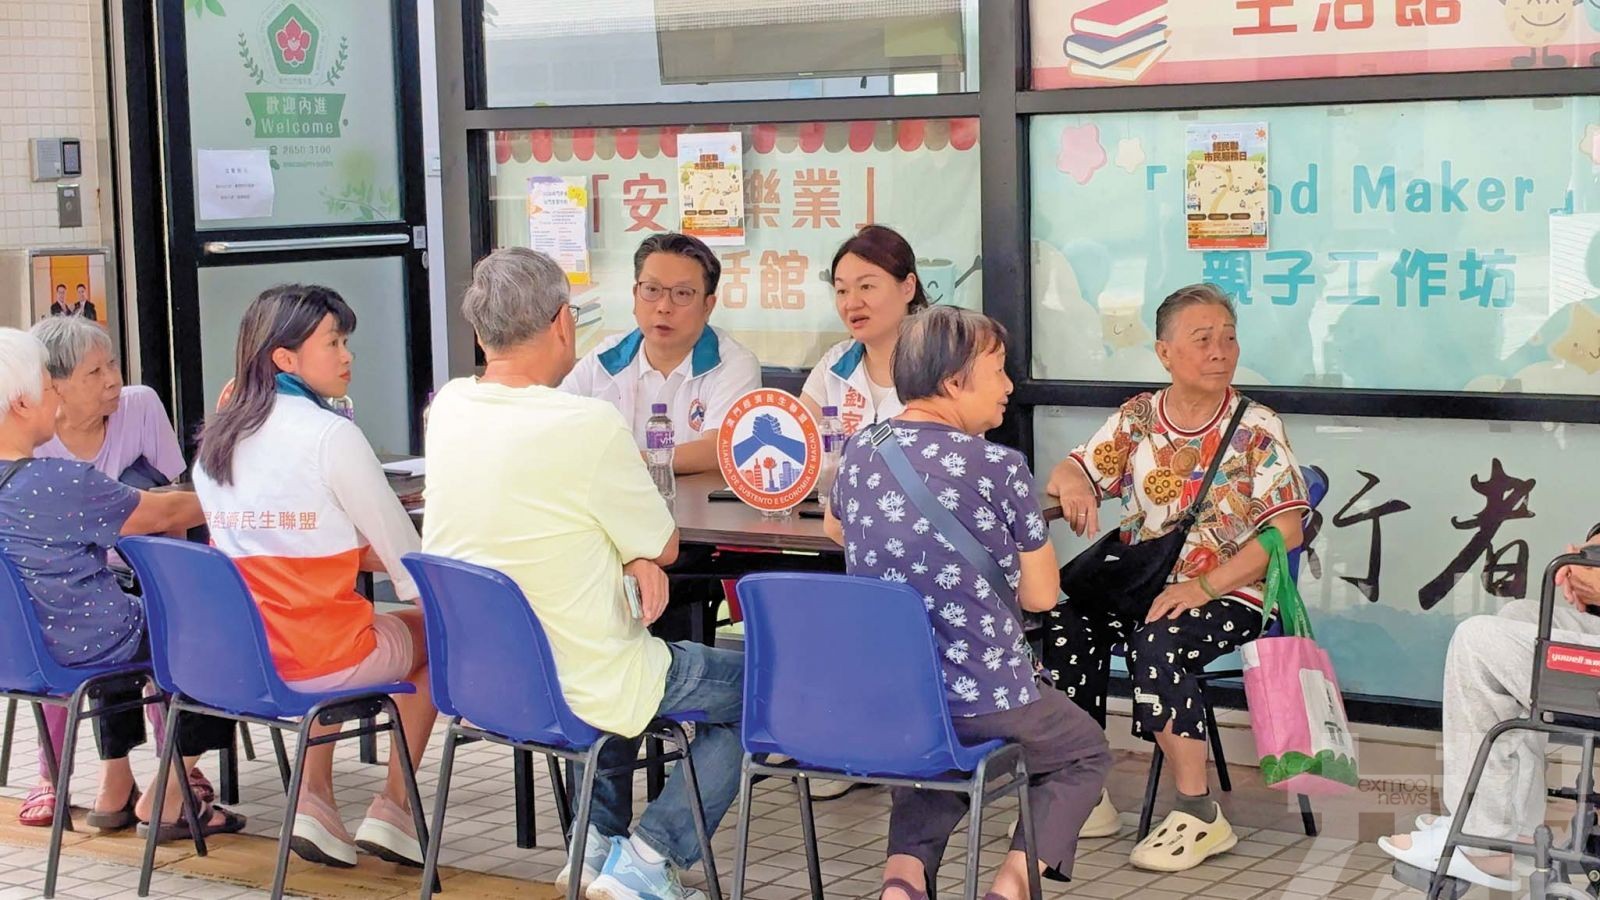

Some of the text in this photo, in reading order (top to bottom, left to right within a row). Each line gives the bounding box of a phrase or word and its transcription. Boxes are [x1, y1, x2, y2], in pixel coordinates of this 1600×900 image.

[266, 95, 328, 115] 歡迎內進
[261, 118, 334, 134] Welcome
[1202, 247, 1518, 308] 親子工作坊
[722, 439, 733, 475] ALIANÇA
[738, 485, 773, 505] SUSTENTO
[780, 476, 811, 505] ECONOMIA
[808, 432, 817, 464] MACAU
